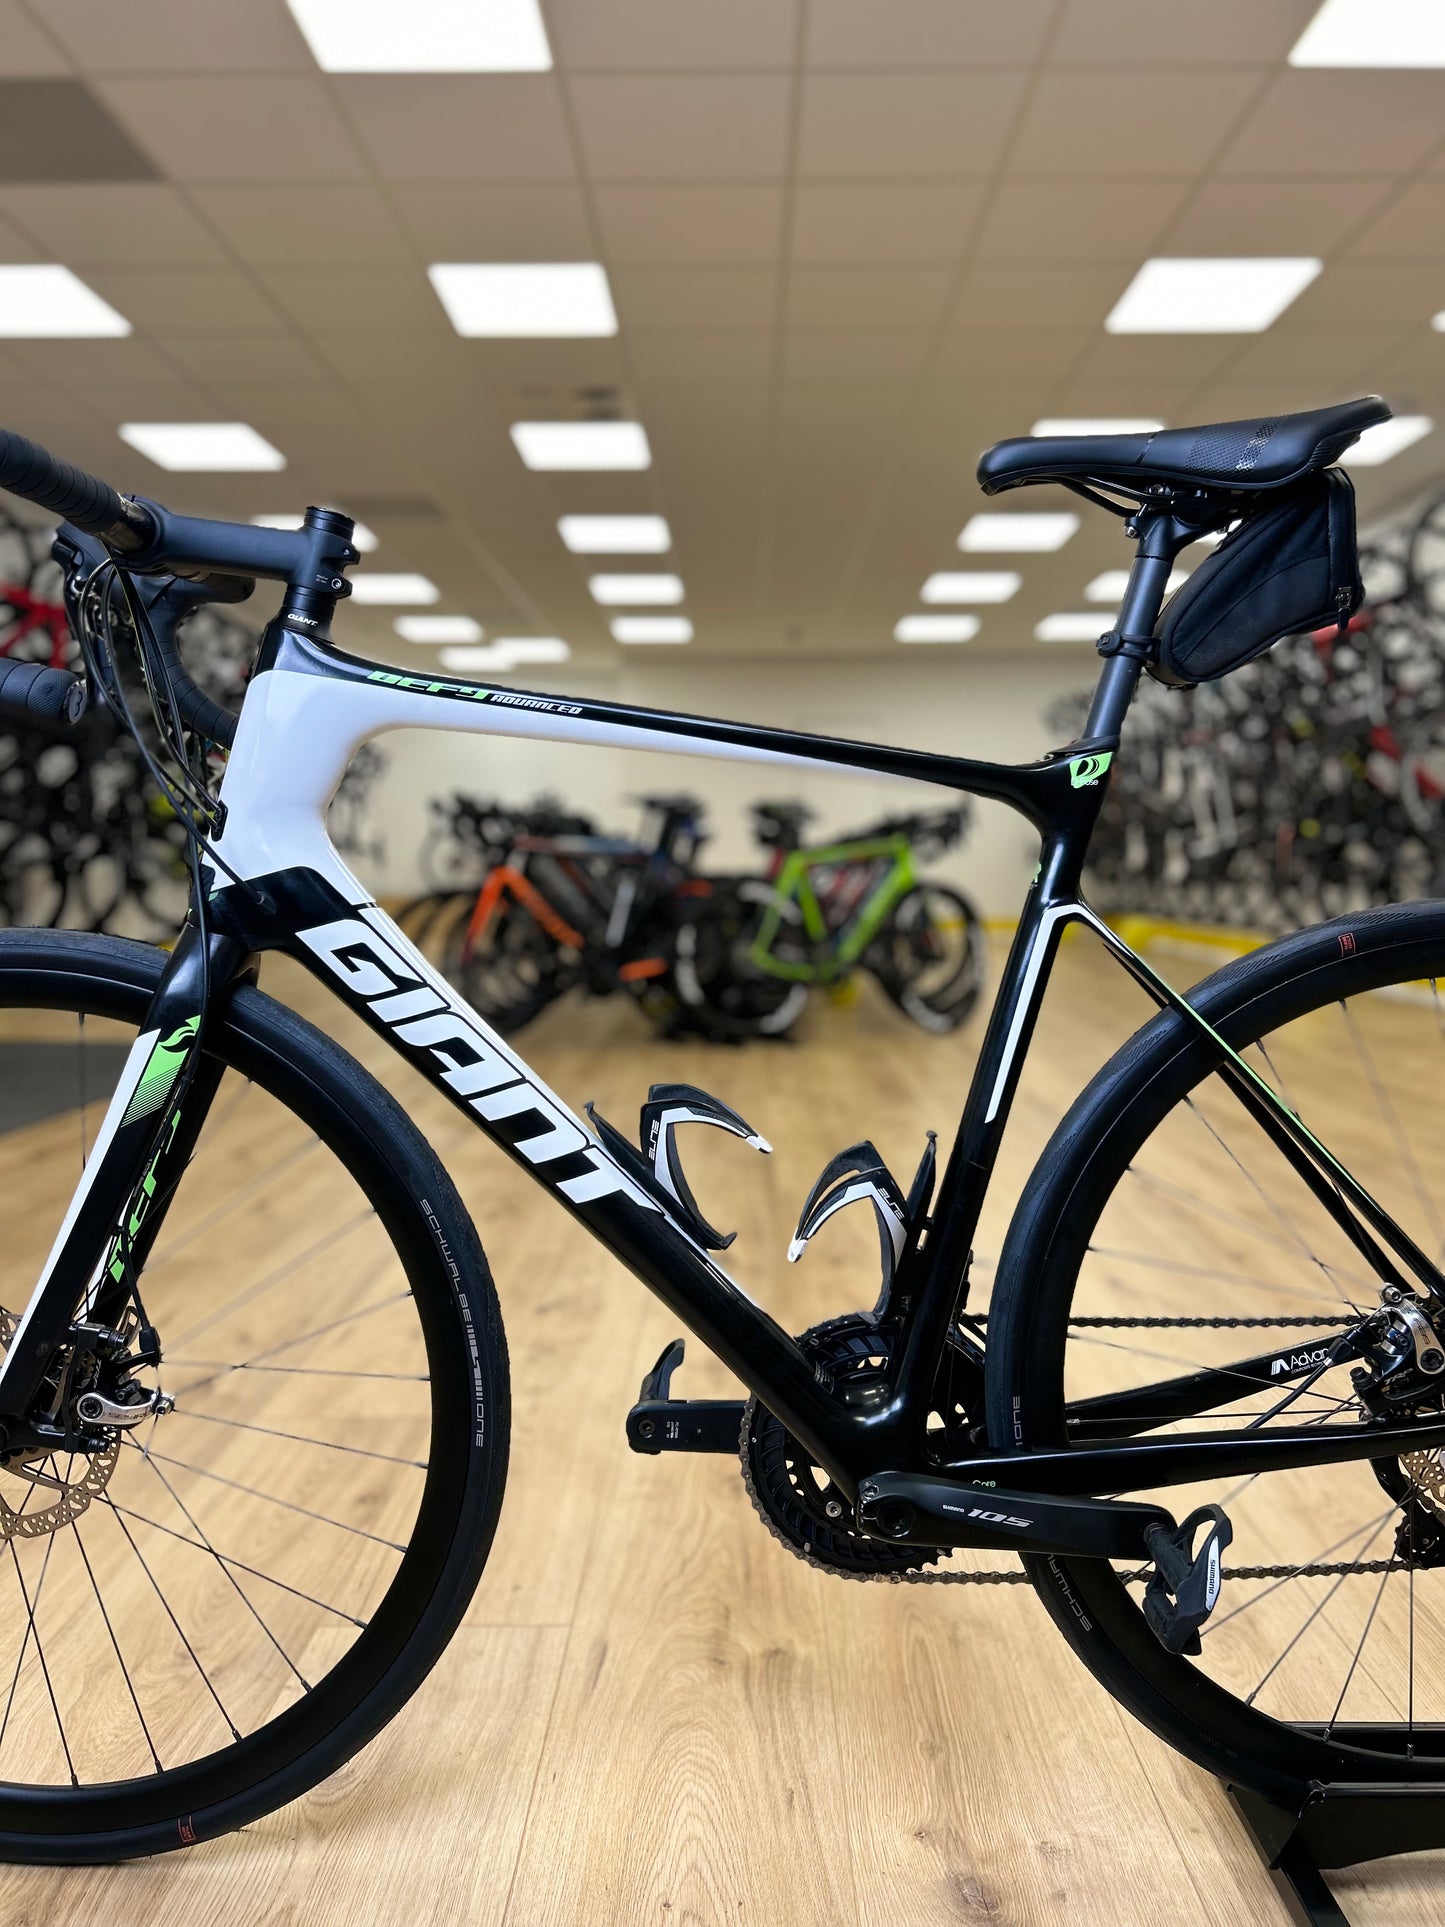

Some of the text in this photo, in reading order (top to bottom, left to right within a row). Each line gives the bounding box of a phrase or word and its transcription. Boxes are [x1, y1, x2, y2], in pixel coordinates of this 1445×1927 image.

[287, 613, 318, 626] GIANT
[490, 694, 583, 716] ADVANCED
[294, 919, 662, 1214] GIANT
[648, 1119, 660, 1161] ELITE
[876, 1187, 905, 1220] ELITE
[419, 1198, 485, 1448] SCHWALBE ONE
[1012, 1395, 1022, 1440] ONE
[967, 1508, 1034, 1528] 105
[1208, 1559, 1216, 1595] SHIMANO
